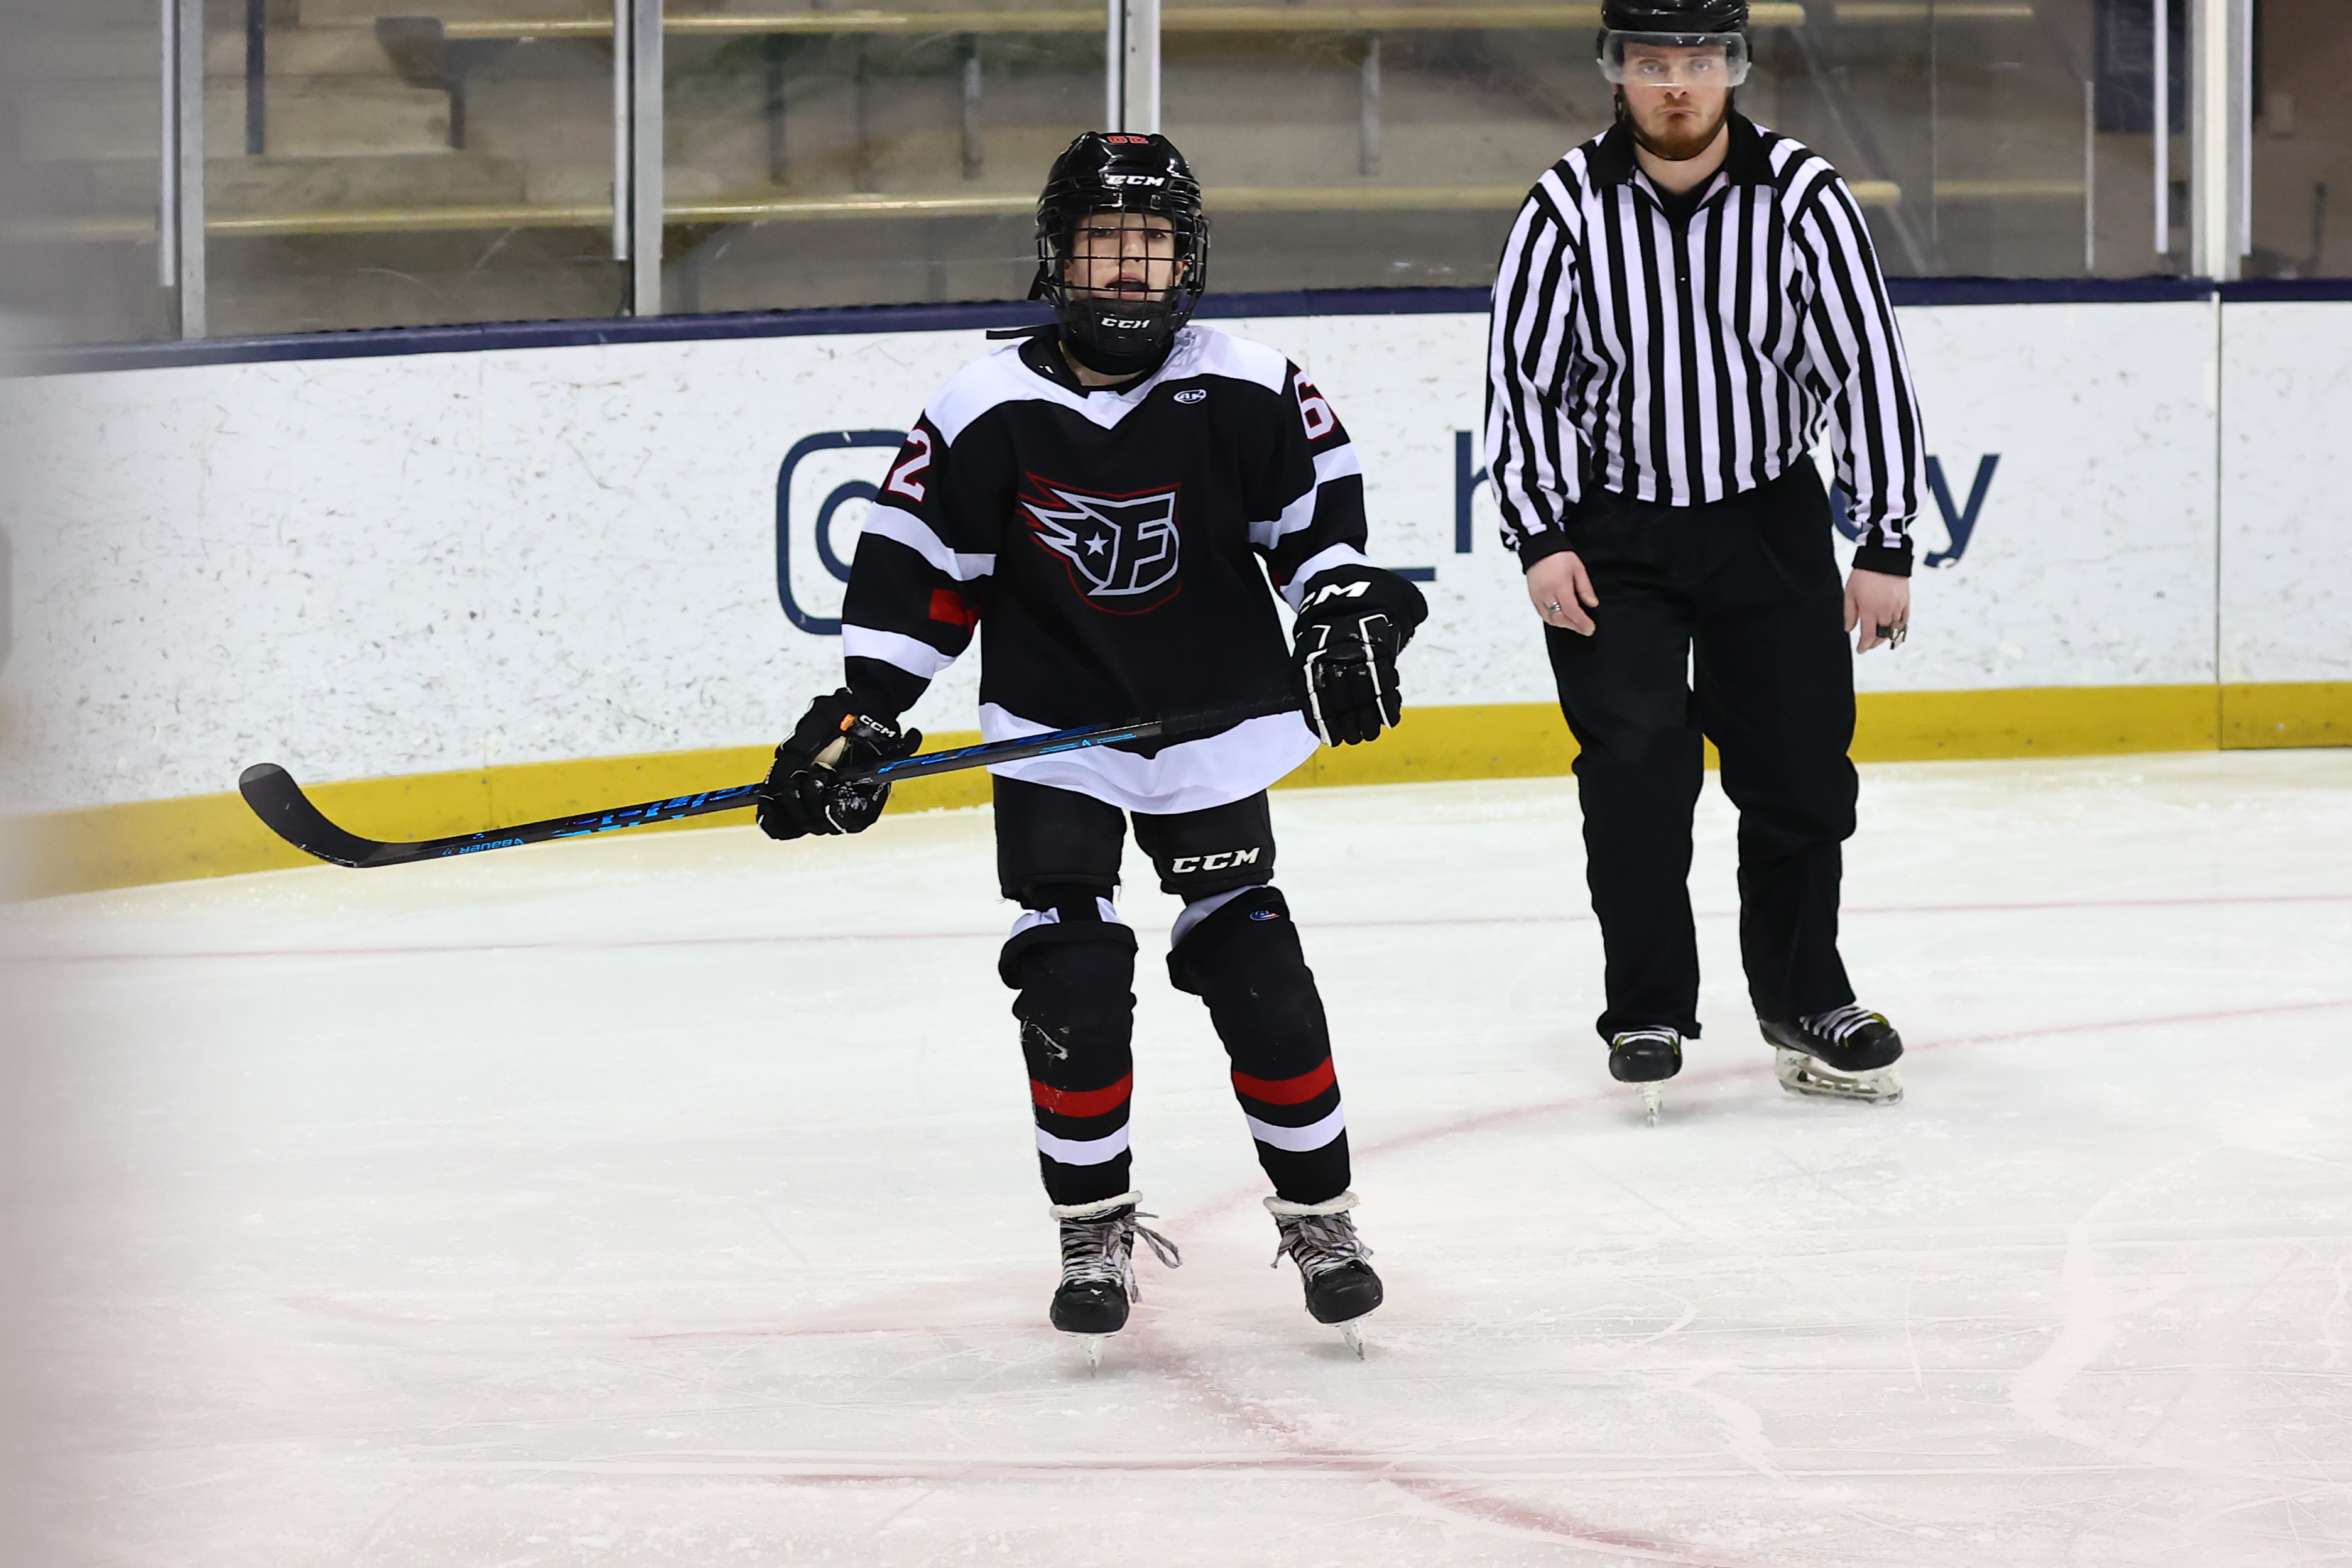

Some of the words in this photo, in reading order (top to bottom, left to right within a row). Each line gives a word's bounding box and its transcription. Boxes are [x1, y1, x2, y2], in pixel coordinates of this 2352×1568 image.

[1105, 175, 1165, 187] CCM
[886, 426, 933, 503] 2
[858, 714, 898, 738] CCM
[459, 838, 512, 854] BAUER
[1172, 846, 1261, 874] CCM
